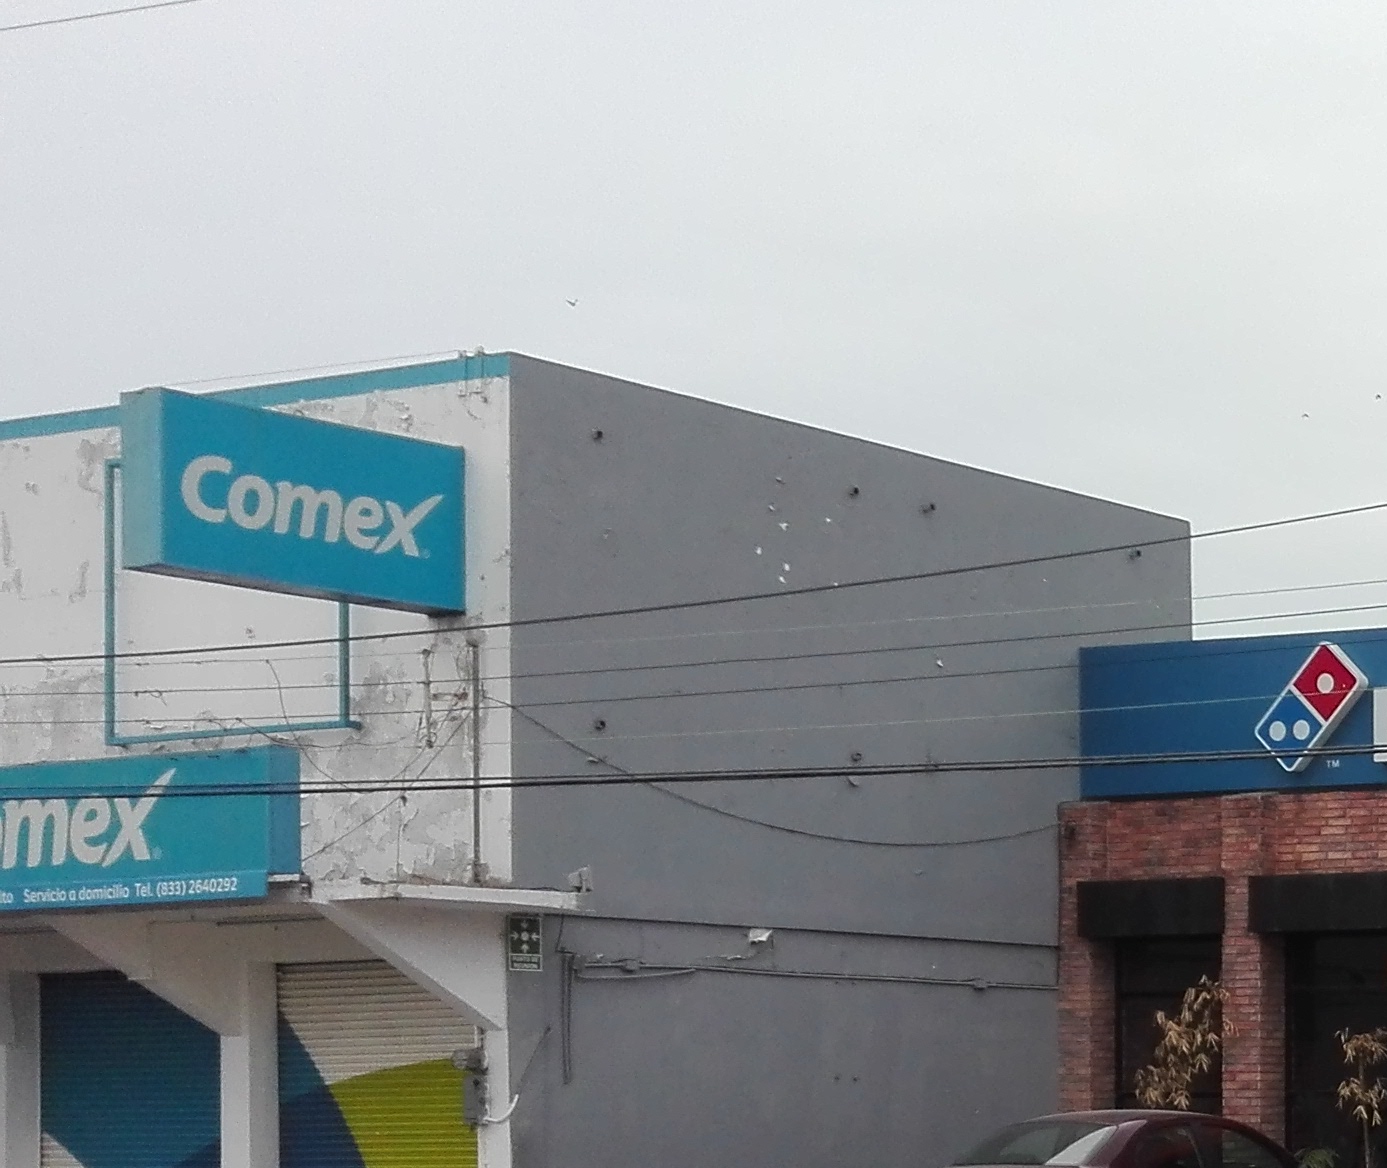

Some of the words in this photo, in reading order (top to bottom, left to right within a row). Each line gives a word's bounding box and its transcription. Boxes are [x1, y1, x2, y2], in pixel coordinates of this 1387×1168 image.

[180, 455, 444, 558] Comex
[0, 767, 177, 870] mex
[23, 888, 67, 903] Servicio
[68, 889, 77, 901] a
[78, 884, 130, 901] domicilio
[156, 880, 187, 898] (833)
[188, 877, 238, 895] 2640292
